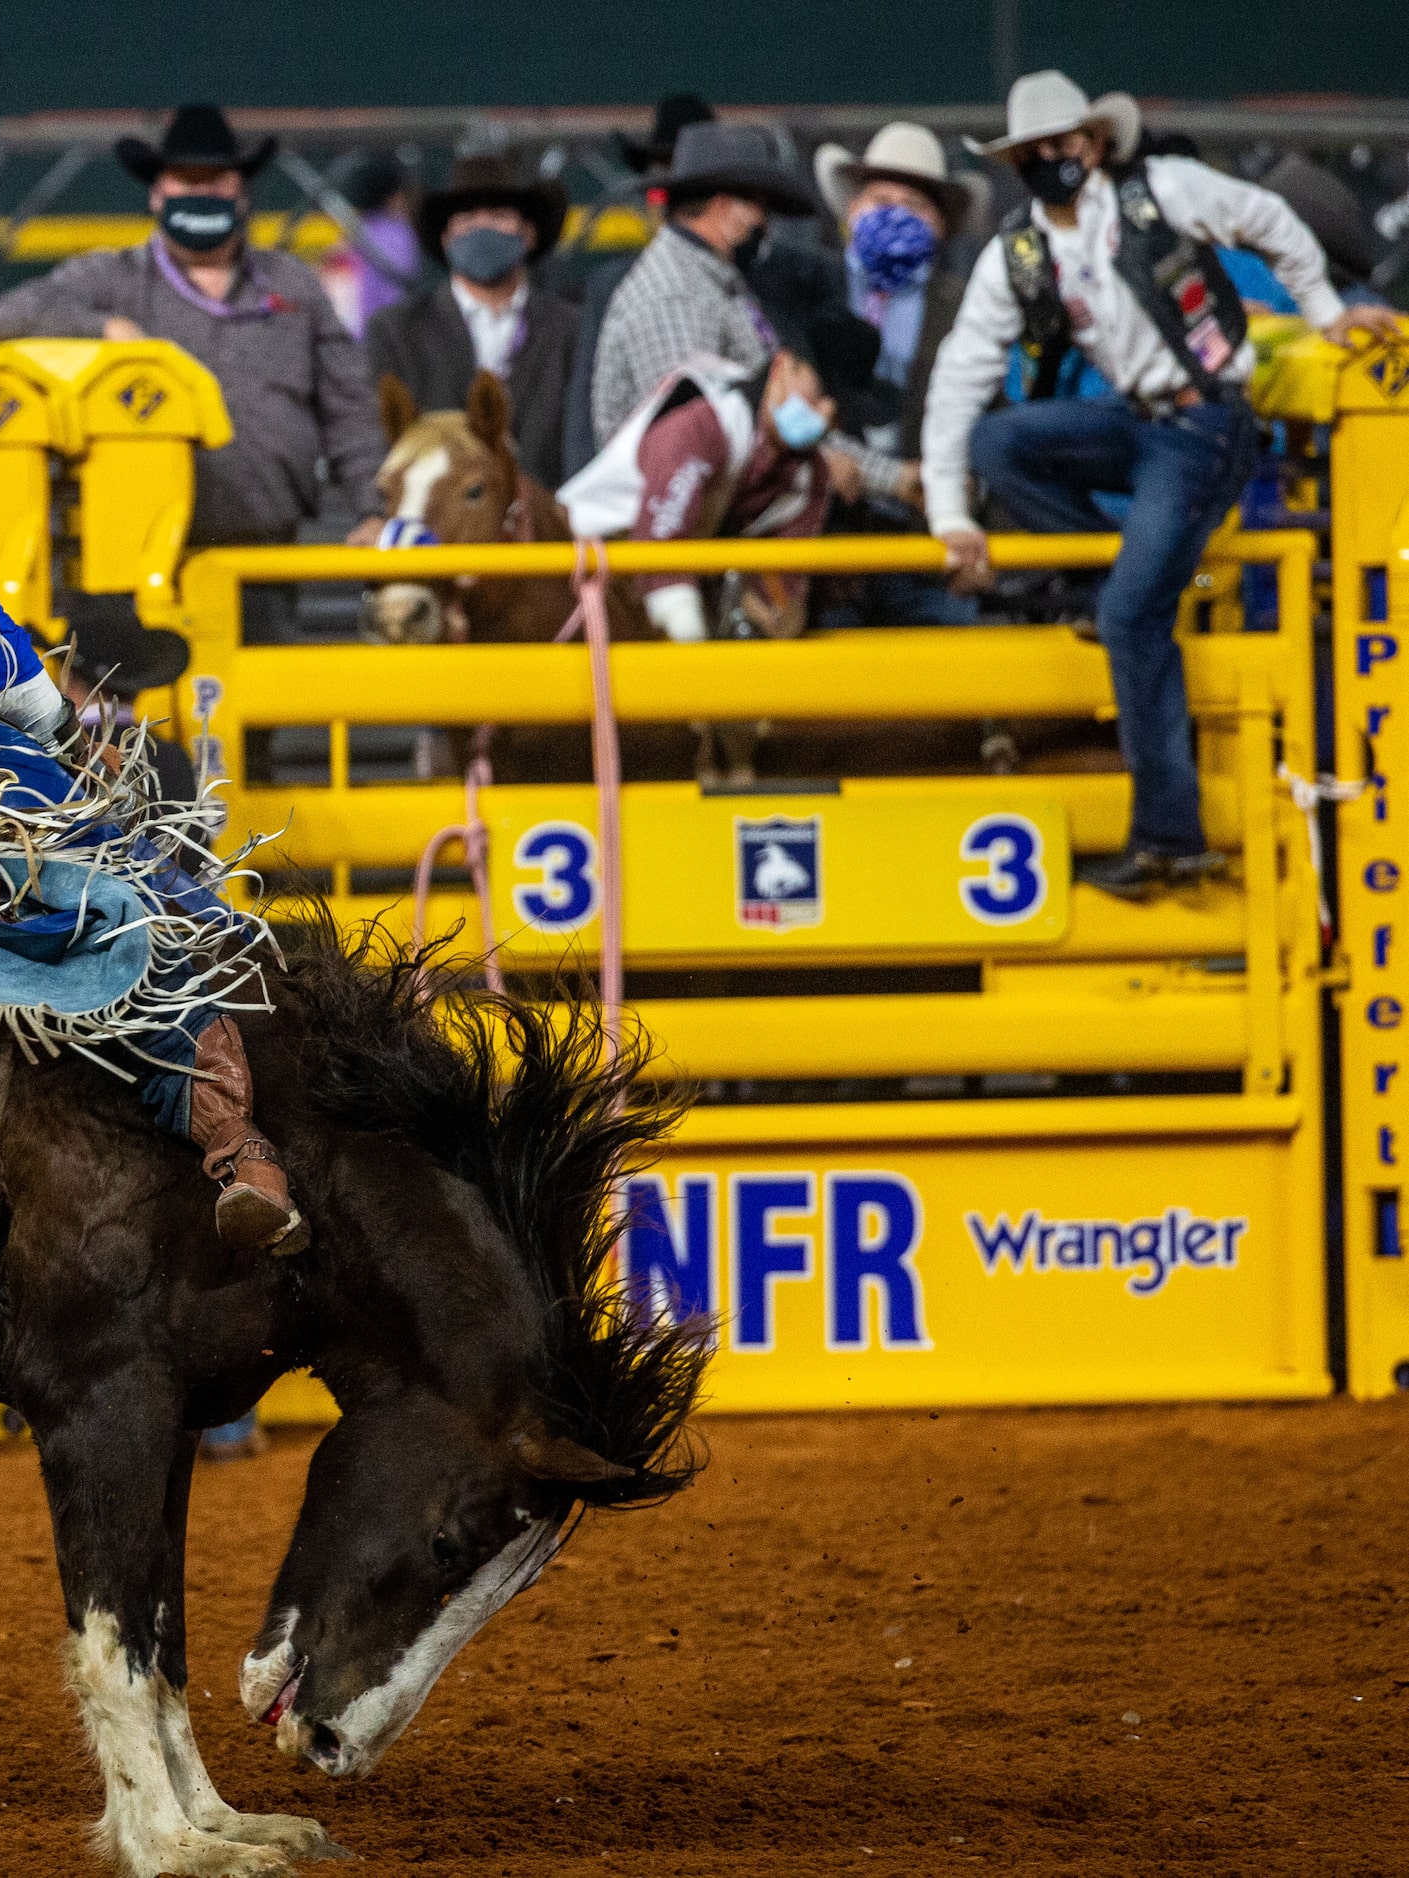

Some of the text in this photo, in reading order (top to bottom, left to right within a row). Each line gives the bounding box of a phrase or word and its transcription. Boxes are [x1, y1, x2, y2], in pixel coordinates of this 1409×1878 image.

[512, 820, 602, 933] 3
[958, 812, 1049, 926] 3
[618, 1170, 934, 1352] NFR
[964, 1207, 1249, 1299] Wrangler
